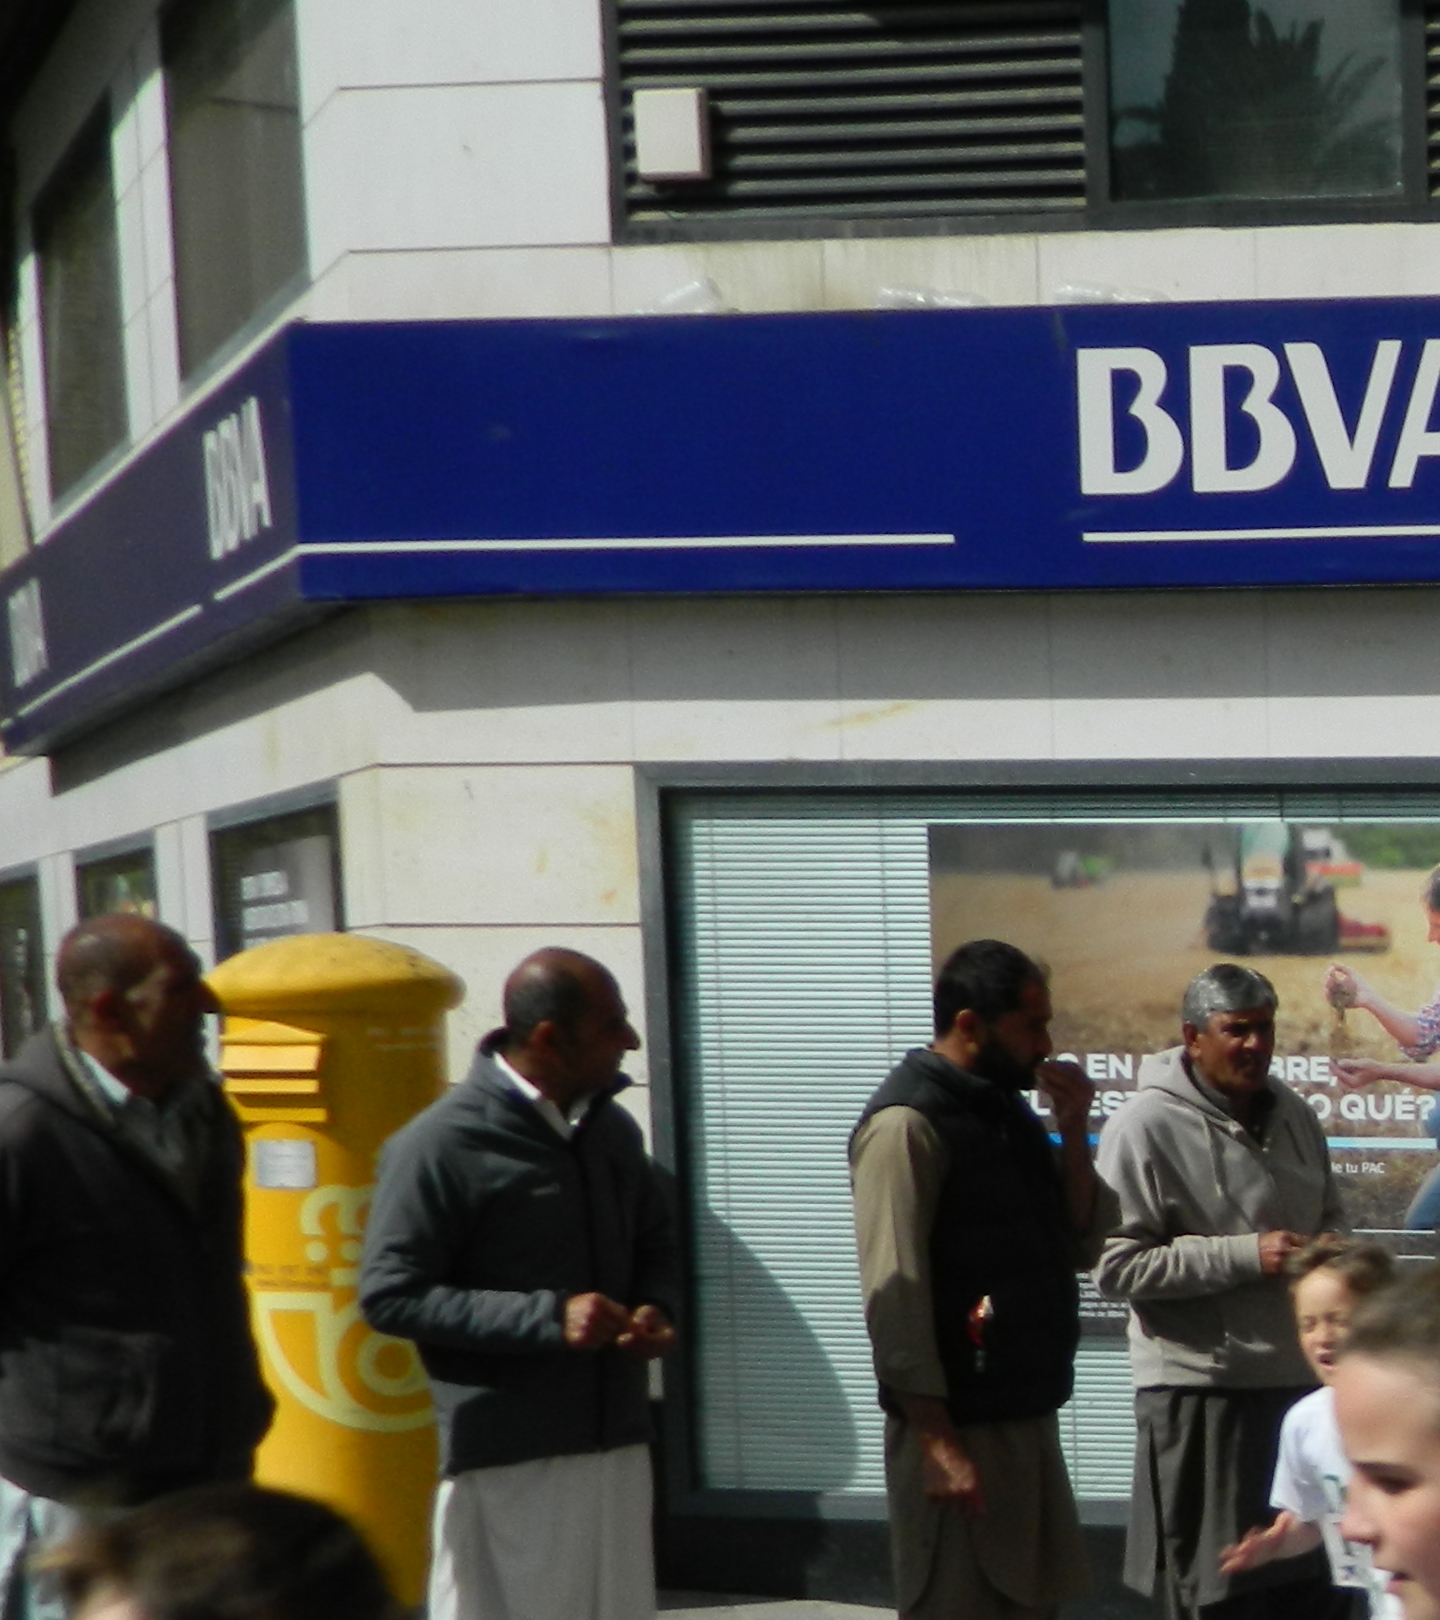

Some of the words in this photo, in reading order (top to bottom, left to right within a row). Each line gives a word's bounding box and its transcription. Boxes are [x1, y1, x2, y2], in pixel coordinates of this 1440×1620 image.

[1086, 1053, 1133, 1079] EN
[1268, 1056, 1338, 1086] BRE,
[1340, 1087, 1437, 1120] QUÉ?
[1362, 1162, 1386, 1174] PAC
